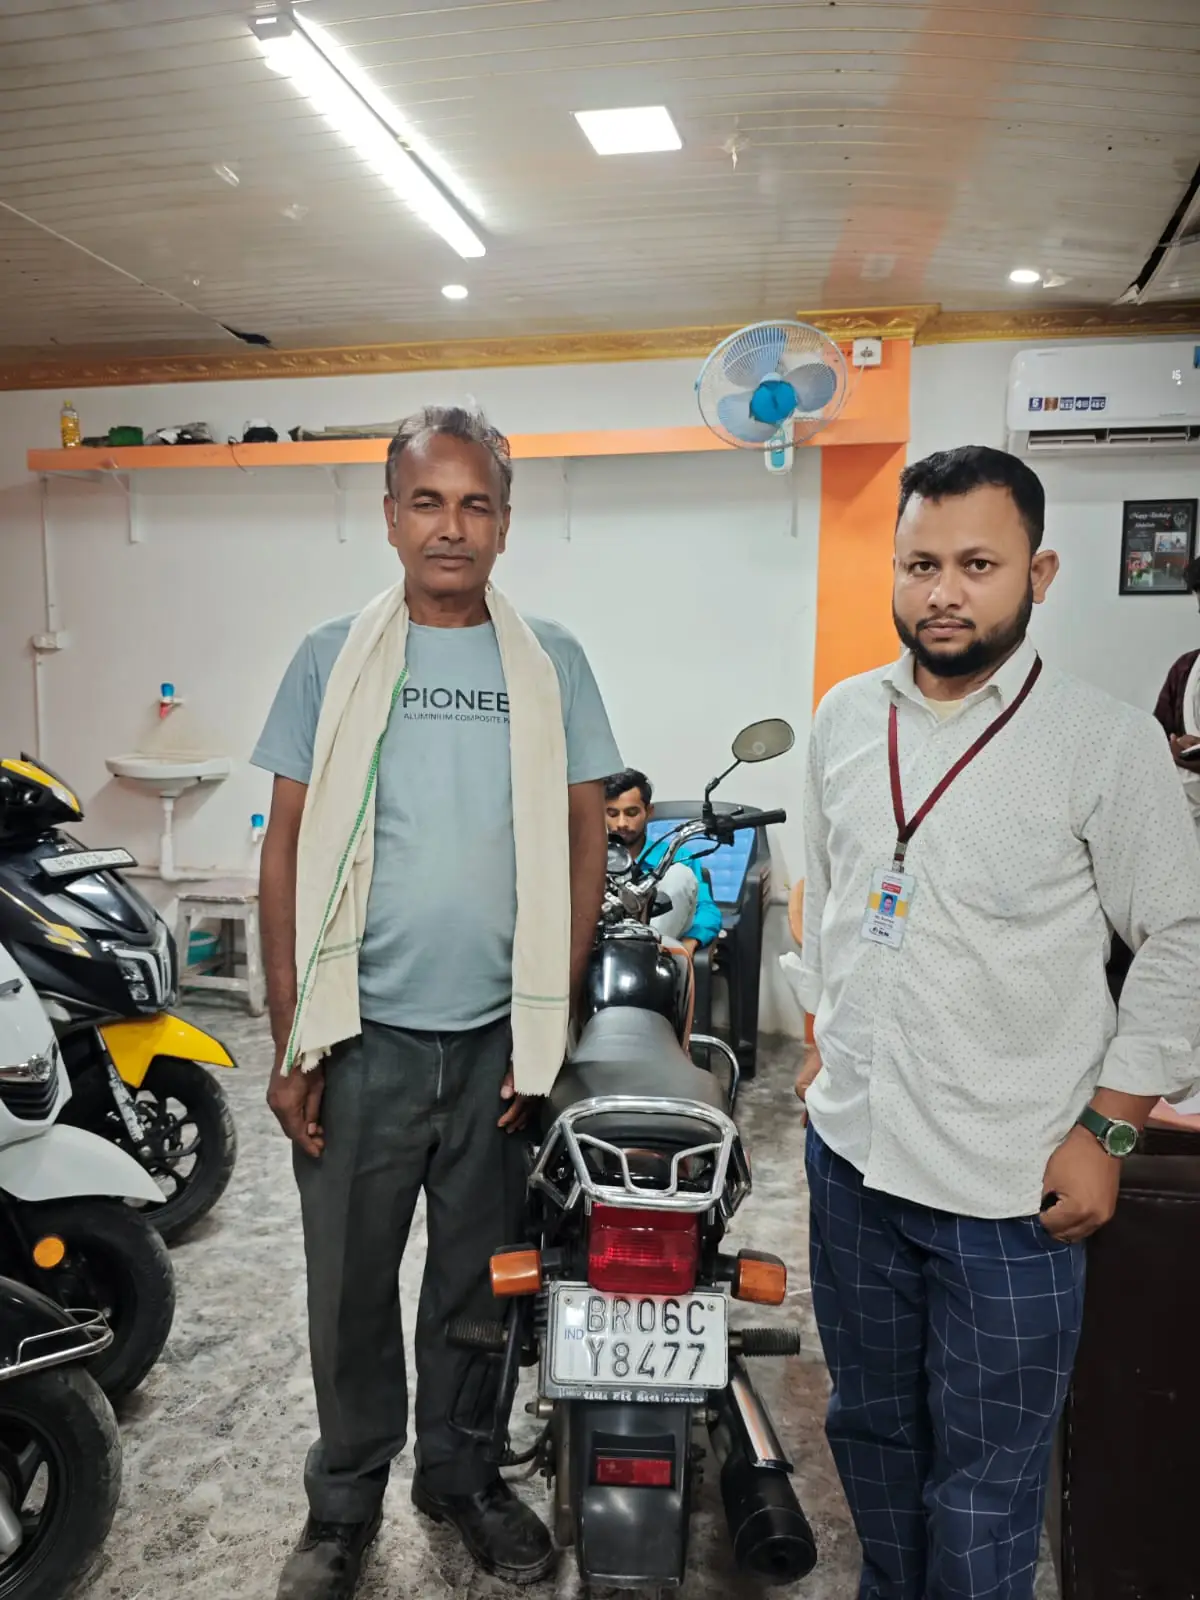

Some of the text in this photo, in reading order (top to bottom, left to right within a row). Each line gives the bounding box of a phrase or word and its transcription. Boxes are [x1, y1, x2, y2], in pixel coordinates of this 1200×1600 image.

[403, 712, 510, 725] ALUMINIUM COMPOSITE P
[586, 1295, 706, 1336] BR06C
[563, 1328, 585, 1341] IND
[586, 1338, 706, 1380] Y8477
